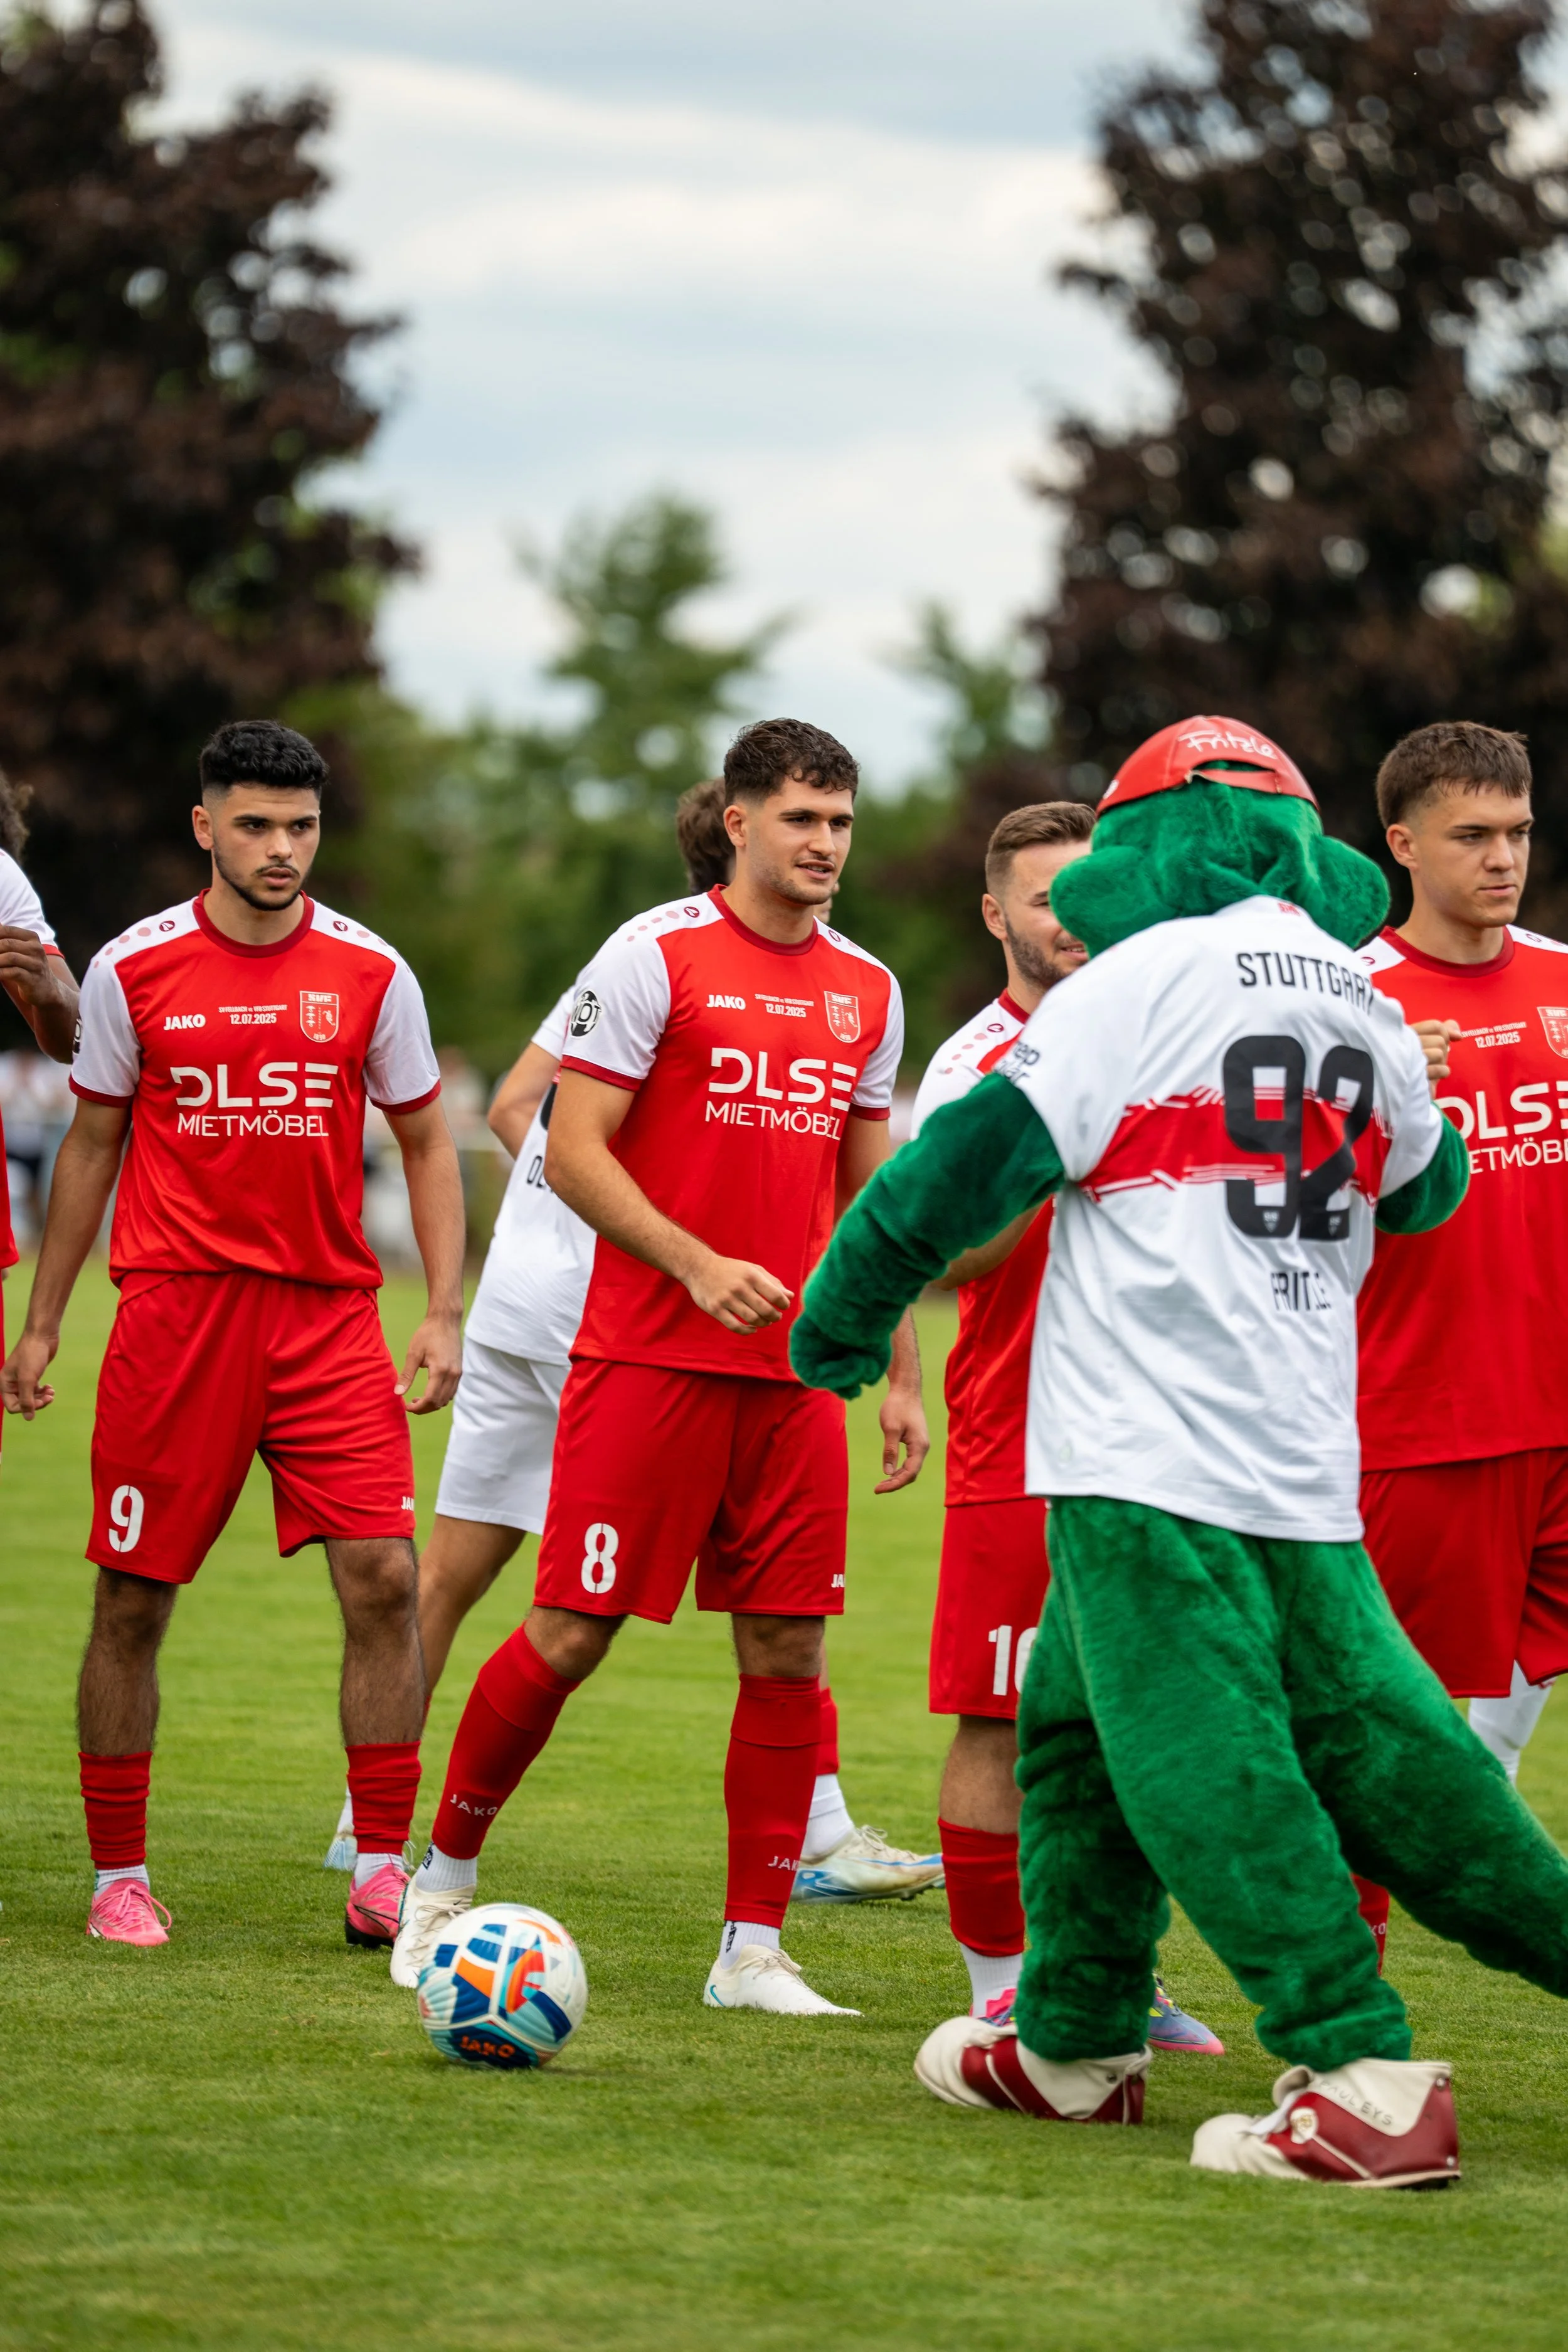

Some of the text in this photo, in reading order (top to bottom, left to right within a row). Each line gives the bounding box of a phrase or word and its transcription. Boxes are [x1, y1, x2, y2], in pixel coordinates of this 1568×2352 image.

[706, 994, 746, 1010] JAKO
[765, 1003, 807, 1018] 12.07.2025
[163, 1014, 206, 1030] JAKO
[230, 1013, 277, 1024] 12.07.2025
[1475, 1031, 1520, 1048] 12.07.2025
[170, 1062, 338, 1108] DLSE
[709, 1047, 857, 1111] DLSE
[177, 1110, 329, 1136] MIETMÖBEL
[705, 1100, 840, 1141] MIETMÖBEL
[1223, 1036, 1374, 1242] 92
[109, 1485, 144, 1553] 9
[581, 1523, 619, 1594] 8
[450, 1794, 498, 1816] JAKO
[459, 2035, 516, 2058] JAKO
